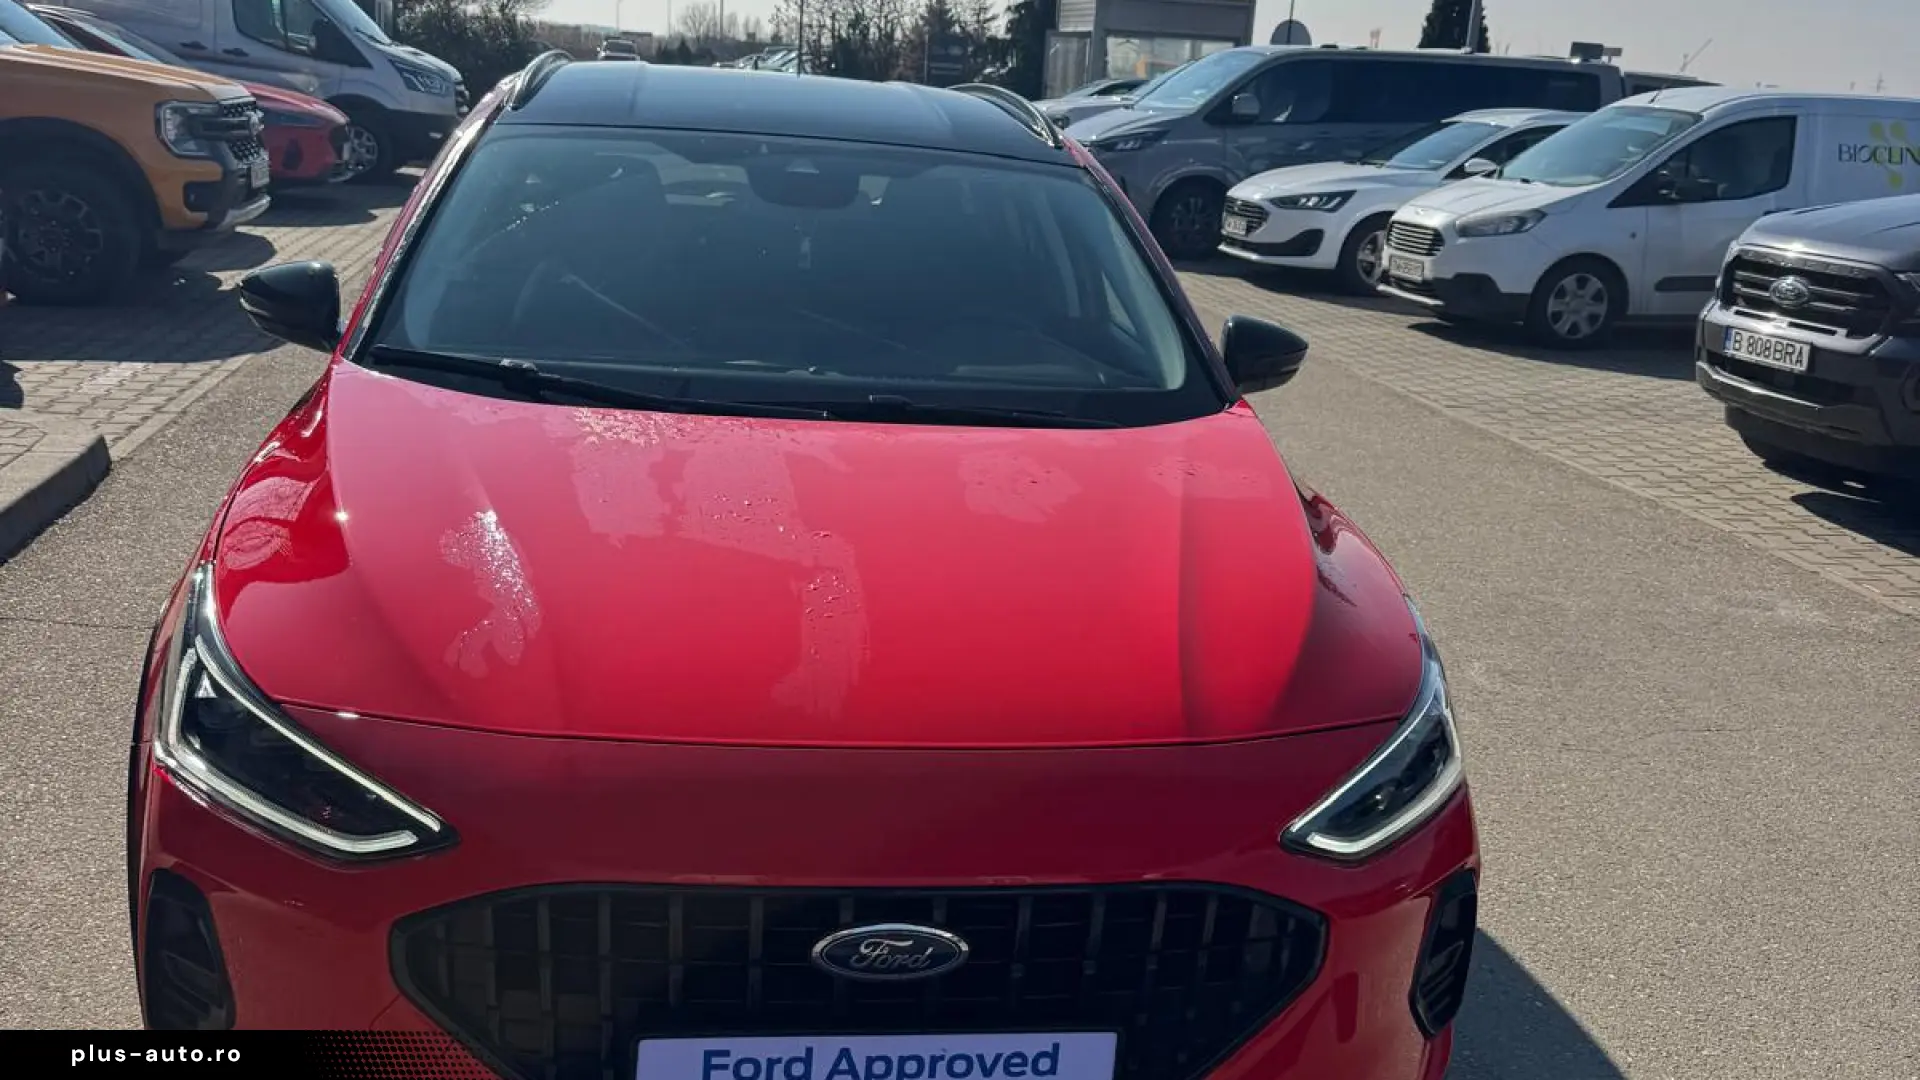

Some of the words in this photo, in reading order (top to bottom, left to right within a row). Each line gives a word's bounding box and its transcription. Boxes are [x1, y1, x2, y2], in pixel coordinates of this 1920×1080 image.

[1732, 330, 1743, 351] B
[850, 937, 935, 970] Ford
[702, 1045, 814, 1080] Ford
[826, 1043, 1060, 1080] Approved
